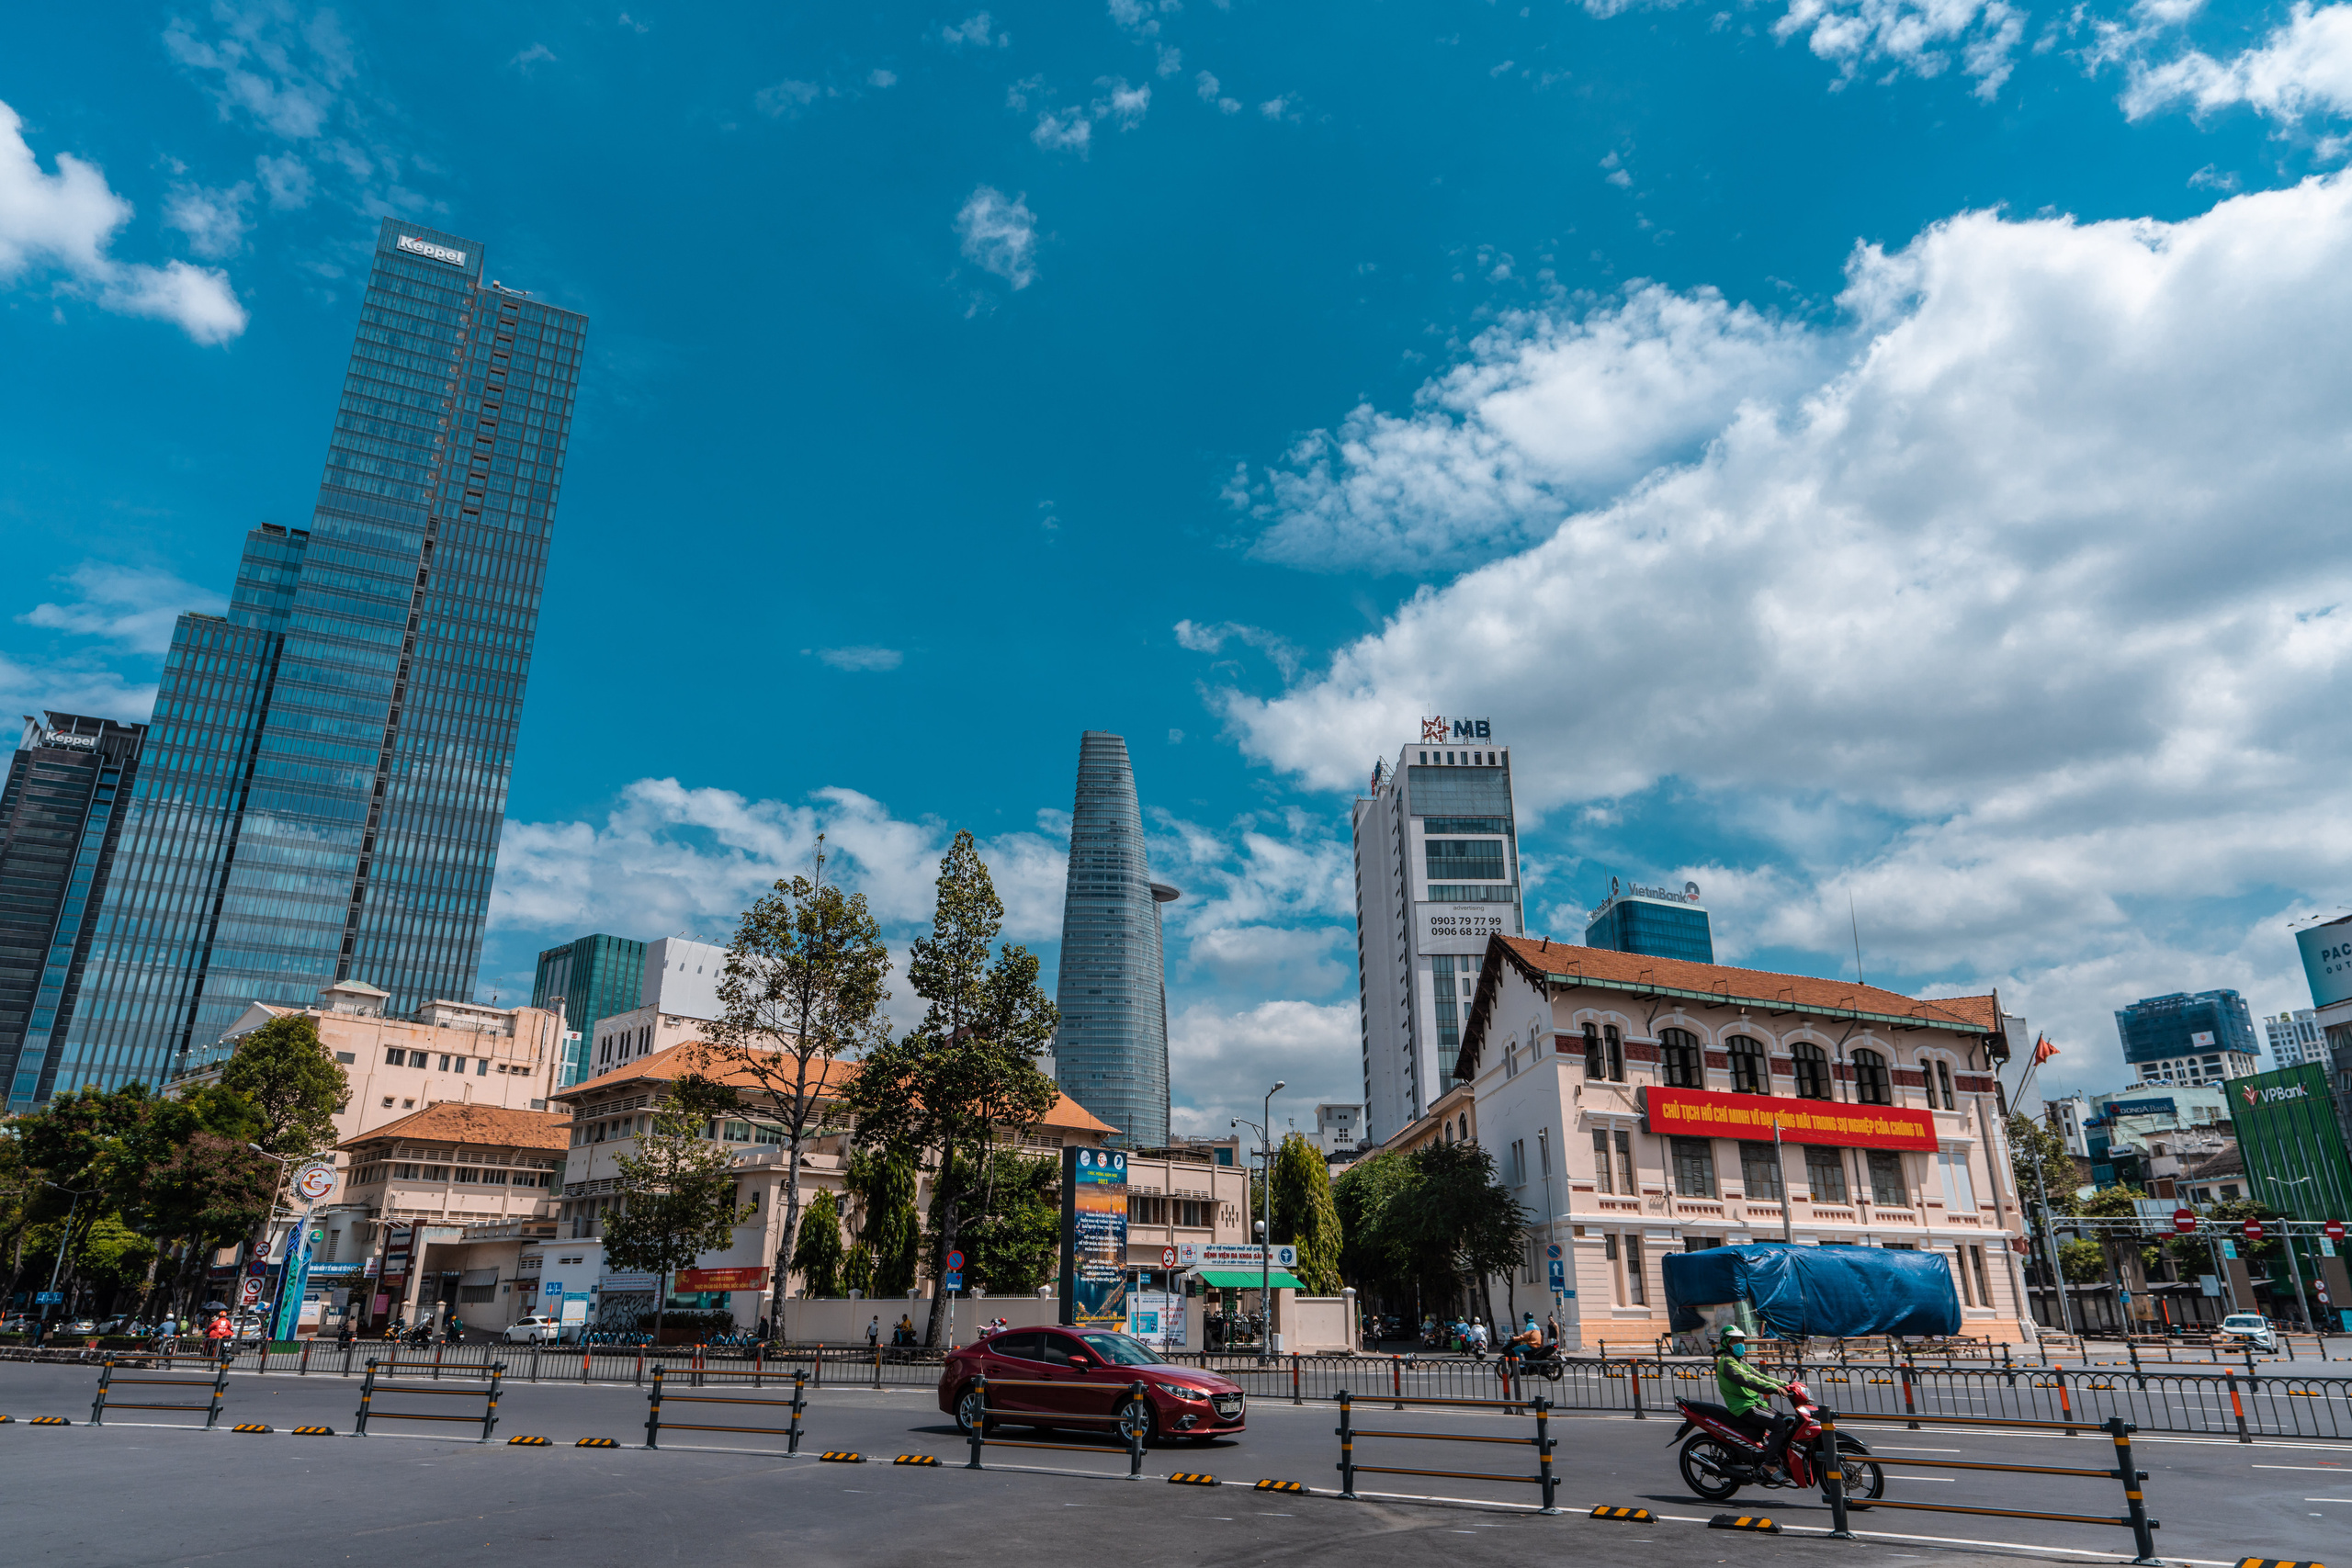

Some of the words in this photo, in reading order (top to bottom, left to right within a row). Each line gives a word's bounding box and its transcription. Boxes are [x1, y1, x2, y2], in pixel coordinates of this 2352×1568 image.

[400, 235, 463, 263] Keppel
[46, 730, 96, 746] Keppel
[1453, 720, 1491, 738] MB
[1628, 882, 1687, 903] VietinBank
[1430, 917, 1455, 925] 0903
[1459, 917, 1471, 925] 79
[1474, 917, 1487, 925] 77
[1488, 917, 1501, 925] 99
[2321, 942, 2352, 962] PAC
[2326, 961, 2351, 974] OUT
[2260, 1082, 2308, 1102] VPBank
[1662, 1100, 1680, 1119] CHỦ
[1680, 1104, 1700, 1122] TỊCH
[1701, 1102, 1713, 1122] HỒ
[1713, 1106, 1728, 1122] CHÍ
[1728, 1108, 1750, 1124] MINH
[1750, 1108, 1760, 1125] VĨ
[1760, 1111, 1774, 1129] ĐẠI
[1774, 1109, 1795, 1128] SỐNG
[1796, 1111, 1811, 1129] MÃI
[1812, 1115, 1837, 1131] TRONG
[1837, 1117, 1848, 1134] SỰ
[1848, 1117, 1874, 1135] NGHIỆP
[1874, 1116, 1890, 1134] CỦA
[1890, 1119, 1915, 1136] CHÚNG
[1915, 1122, 1925, 1137] TA
[1204, 1251, 1217, 1260] BỆNH
[1218, 1251, 1229, 1259] VIỆN
